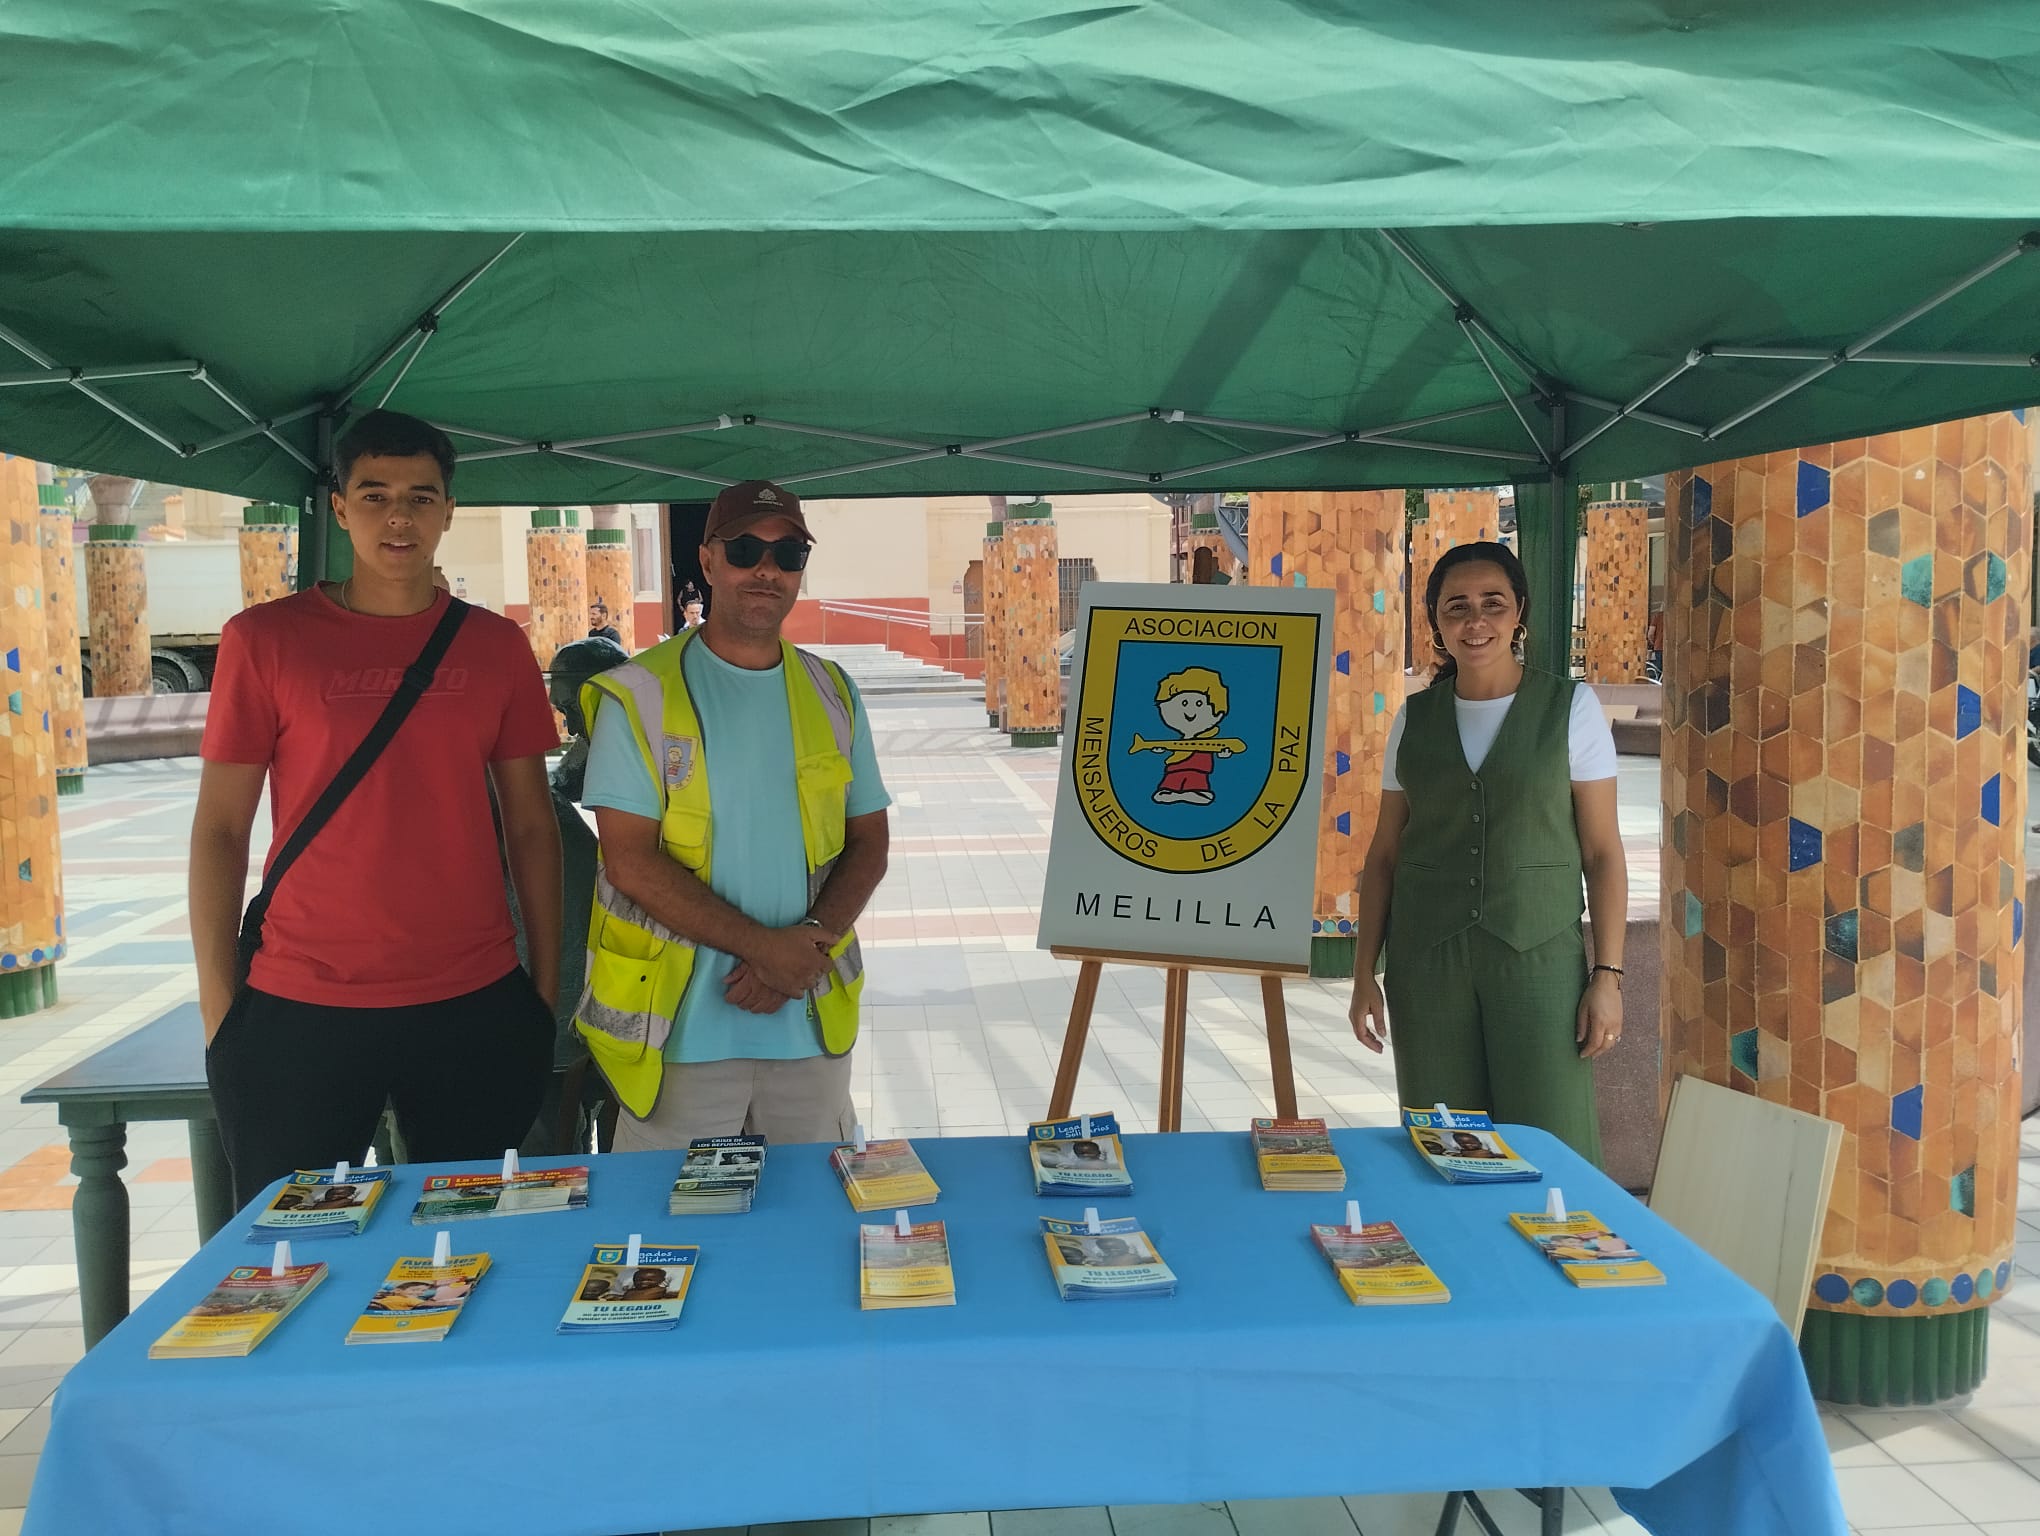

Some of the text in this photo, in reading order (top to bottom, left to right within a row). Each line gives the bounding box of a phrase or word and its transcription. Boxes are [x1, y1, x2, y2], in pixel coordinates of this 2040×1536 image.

[1124, 617, 1278, 640] ASOCIACION
[331, 667, 468, 692] MORTO
[1082, 716, 1301, 863] MENSAJEROS DE LA PAZ
[1075, 892, 1277, 930] MELILLA
[1058, 1122, 1095, 1133] Legas
[1065, 1125, 1110, 1138] Soliarios
[639, 1251, 672, 1260] gados
[612, 1304, 662, 1312] LEGADO
